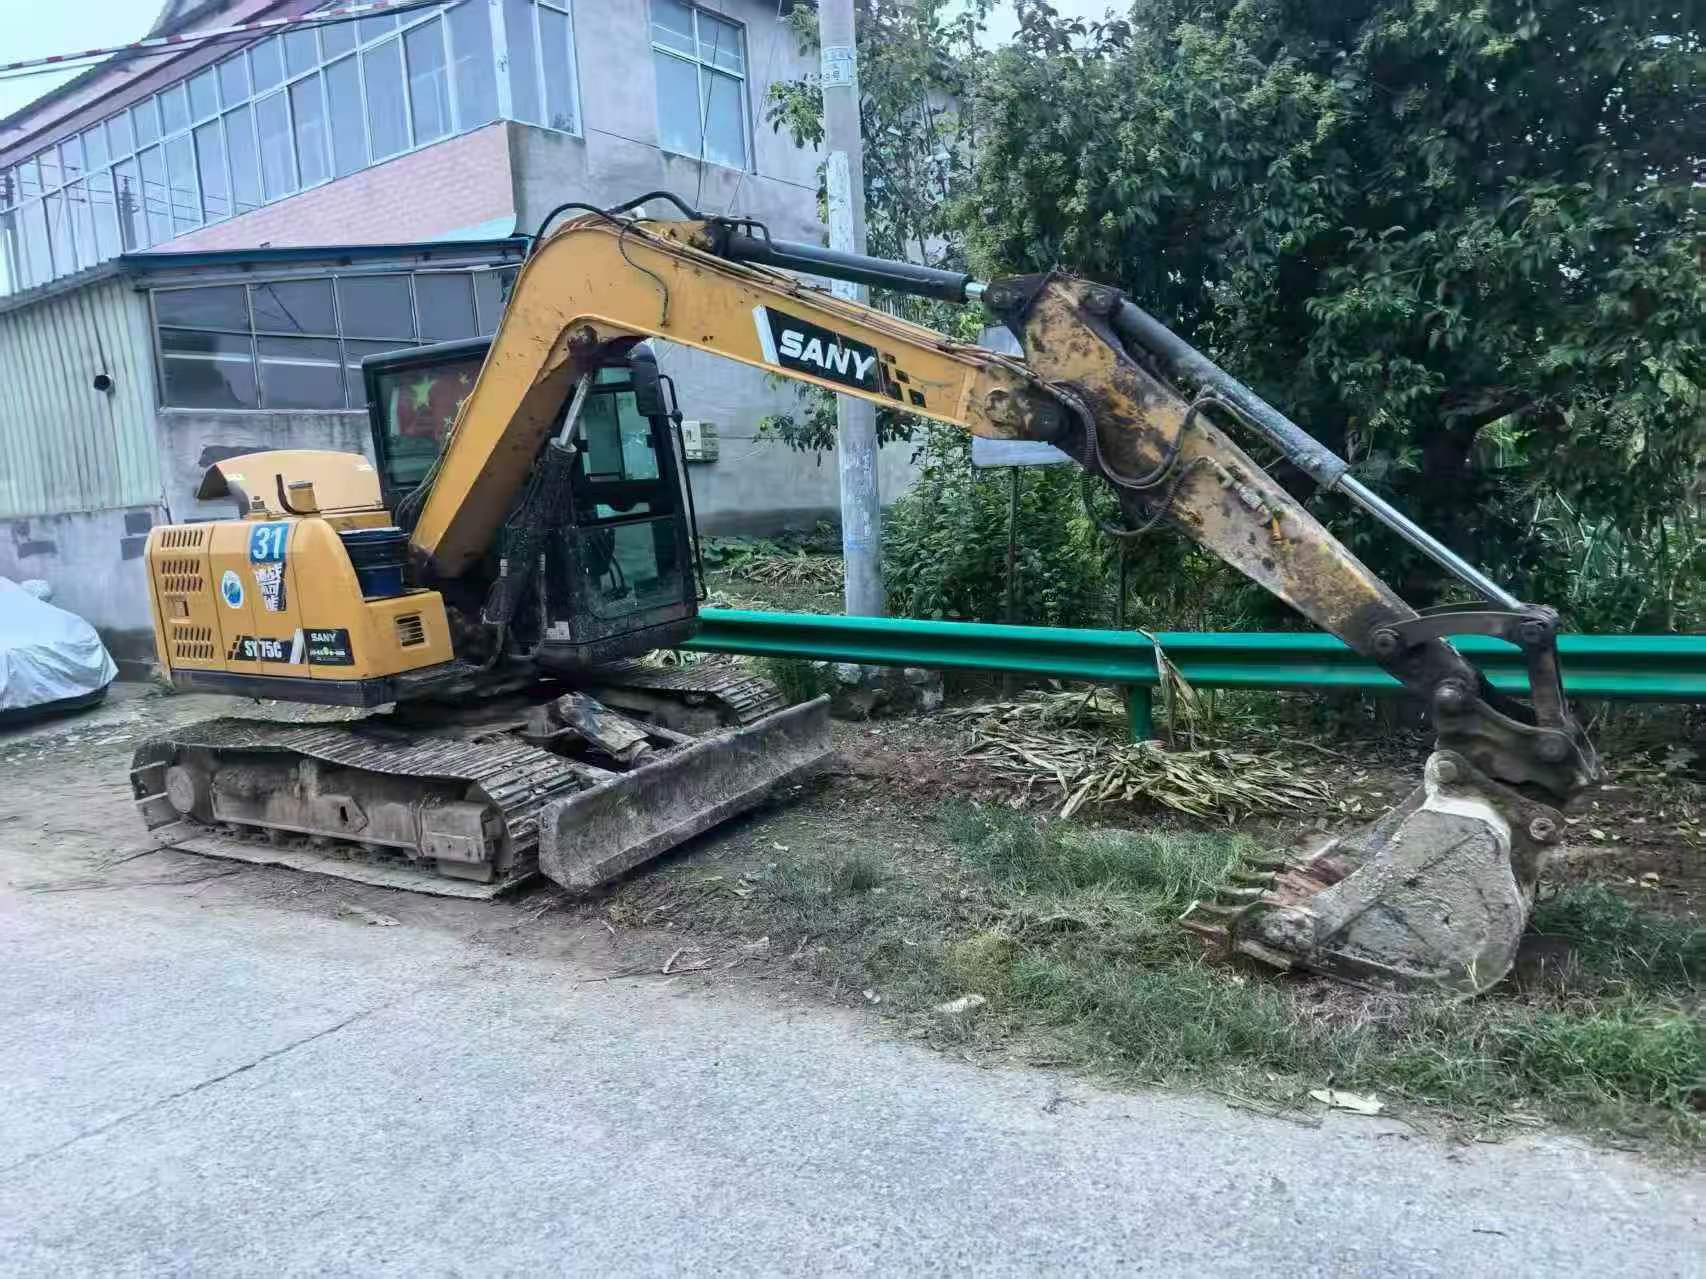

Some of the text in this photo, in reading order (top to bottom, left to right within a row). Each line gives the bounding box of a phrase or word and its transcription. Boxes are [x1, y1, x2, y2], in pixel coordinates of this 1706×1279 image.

[780, 329, 875, 380] SANY
[253, 527, 281, 559] 31
[244, 640, 283, 658] SY75C
[310, 632, 337, 642] SANY
